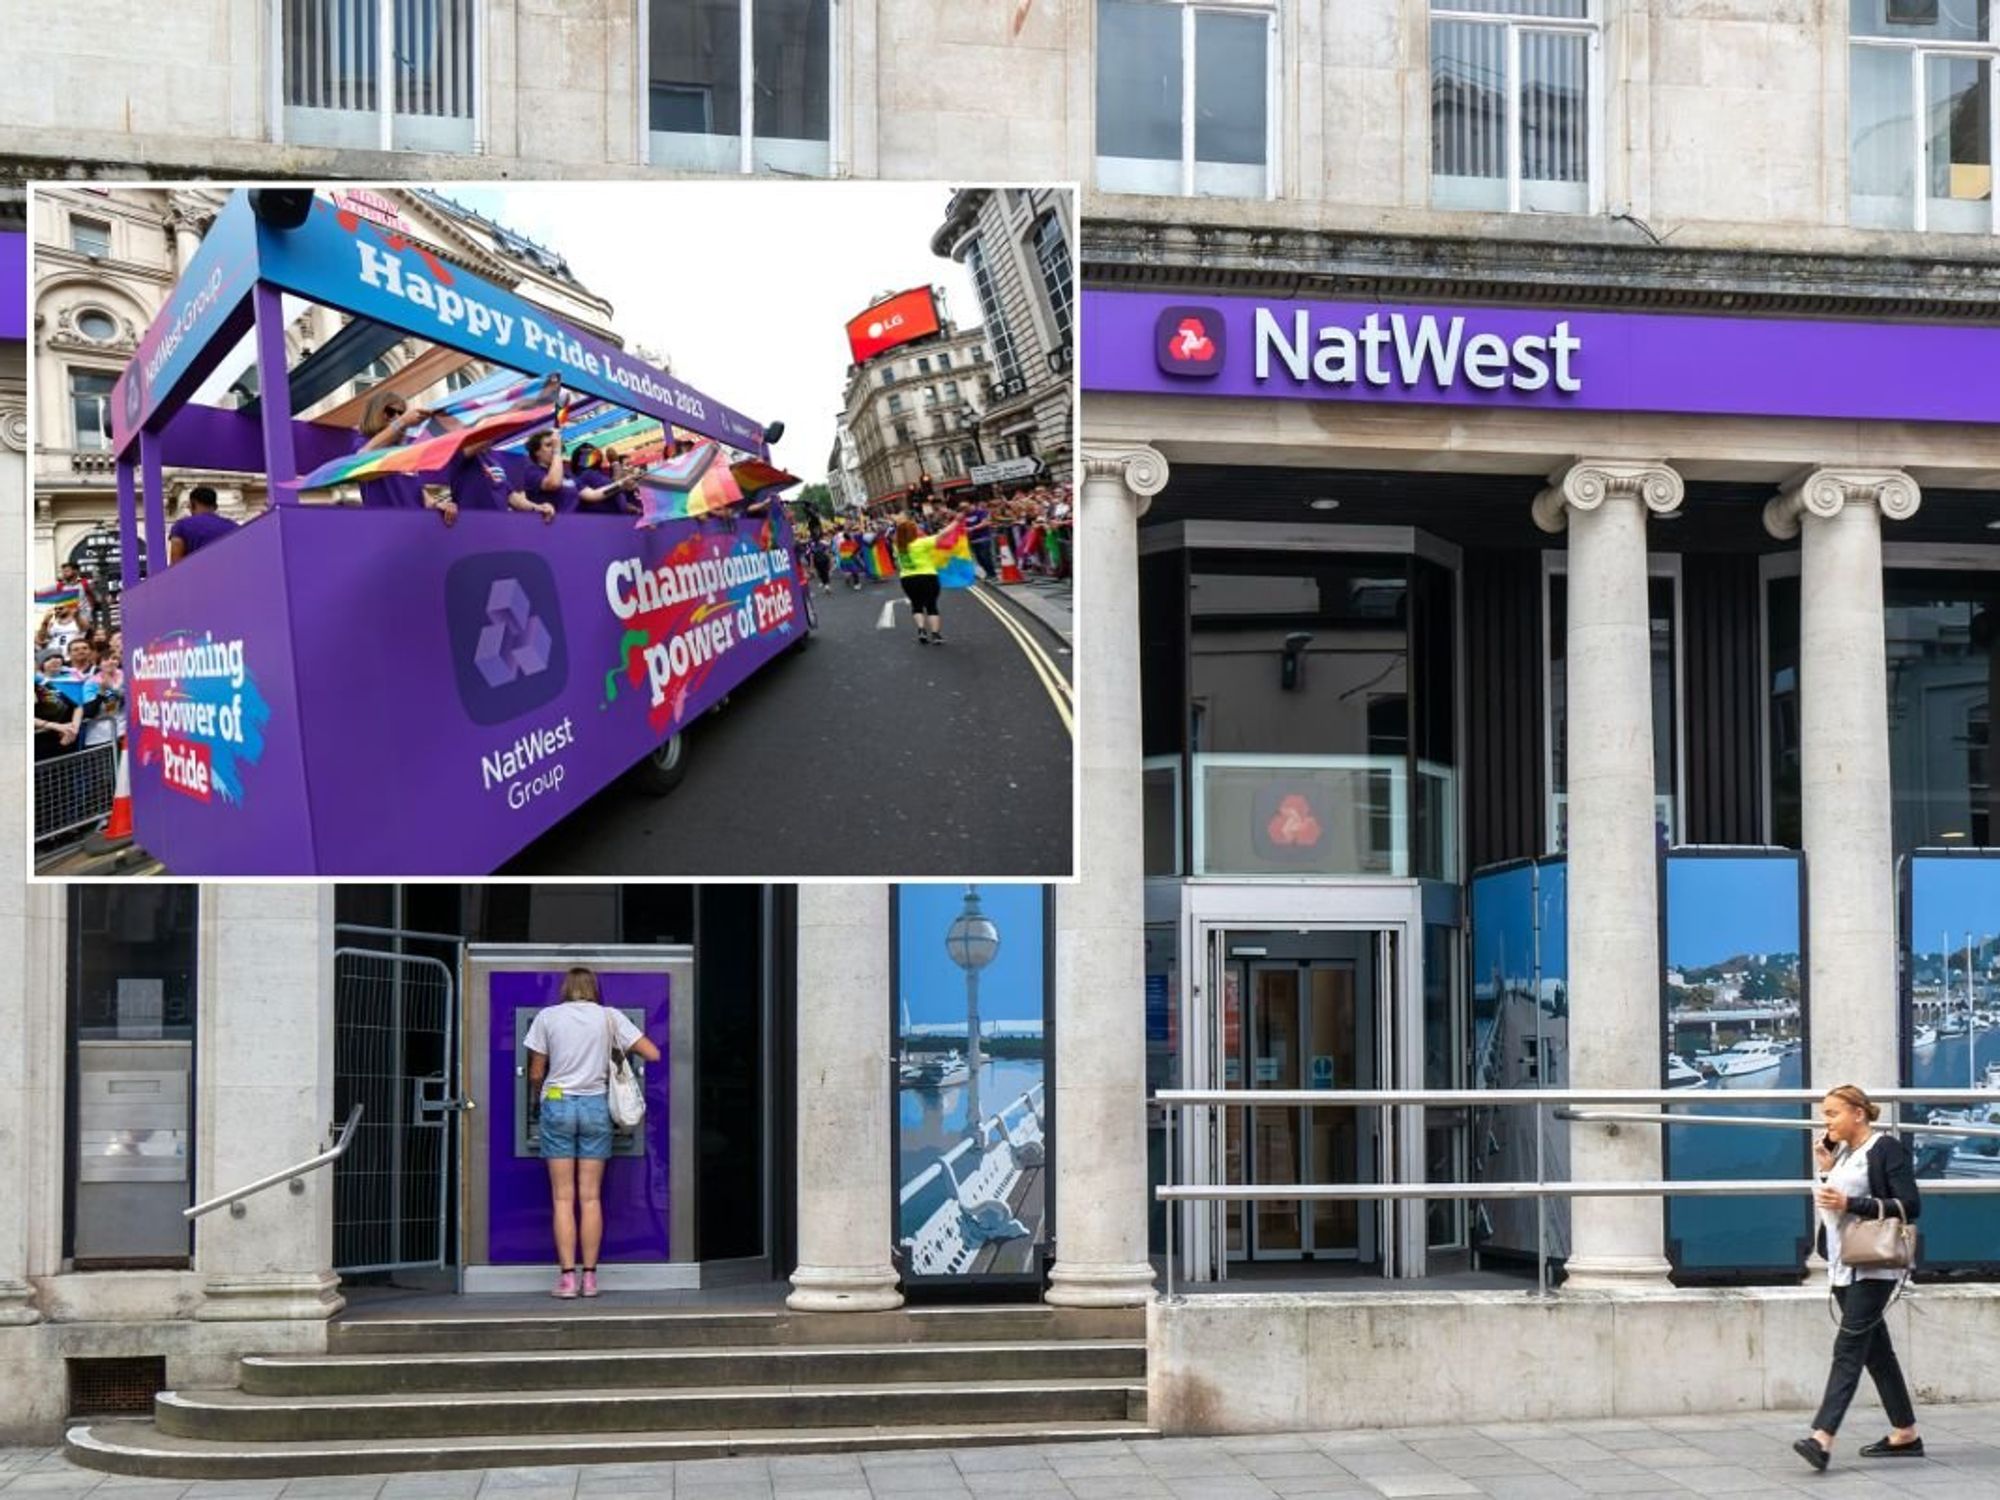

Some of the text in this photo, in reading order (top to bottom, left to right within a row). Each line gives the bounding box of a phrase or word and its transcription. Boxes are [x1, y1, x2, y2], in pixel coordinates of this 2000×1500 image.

[183, 266, 222, 333] Group
[356, 239, 706, 420] Happy Pride London 2023
[883, 314, 904, 331] LG
[1255, 307, 1582, 391] NatWest
[605, 542, 771, 620] Championing
[132, 630, 244, 689] Championing
[643, 582, 793, 706] power of Pride
[138, 692, 244, 744] the power of
[163, 743, 209, 794] Pride
[481, 716, 575, 790] NatWest
[508, 764, 564, 810] Group
